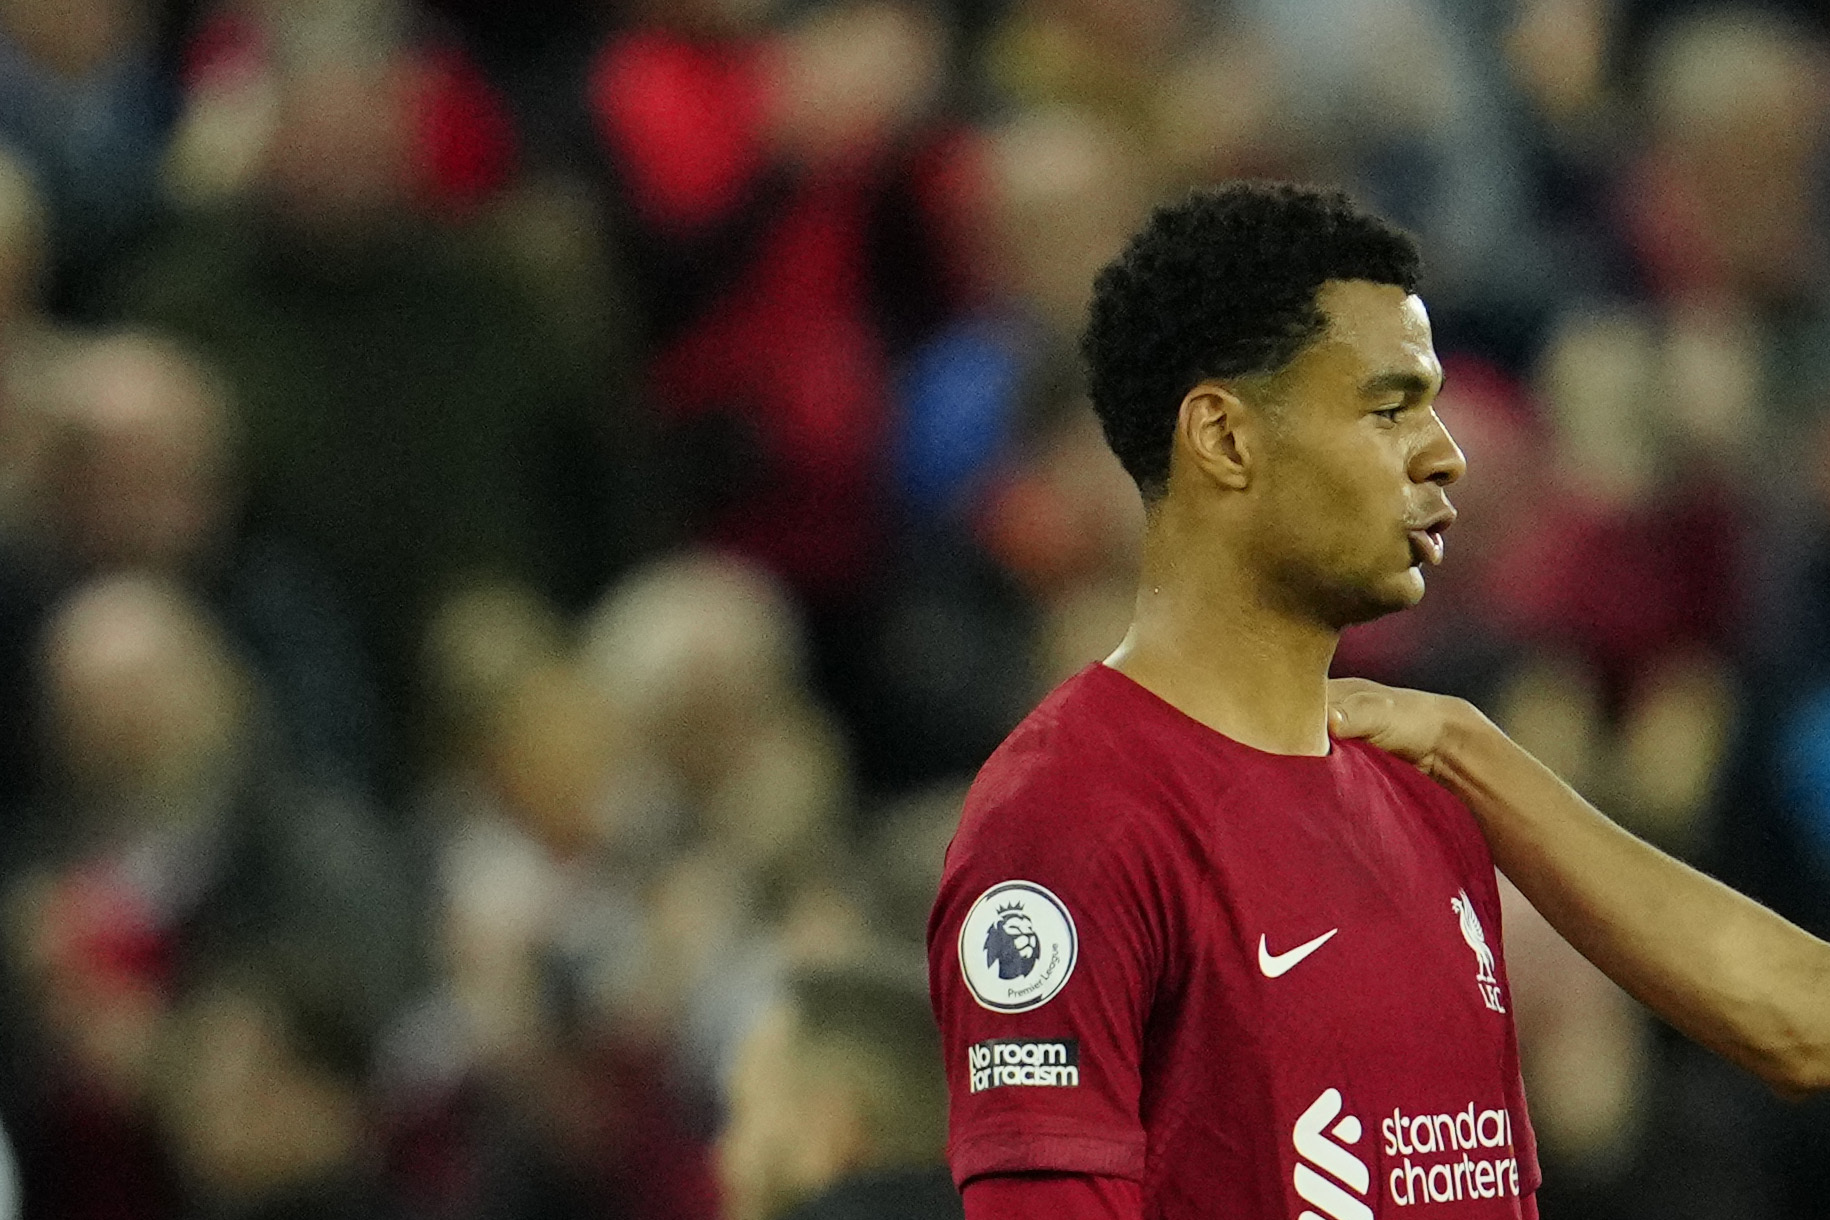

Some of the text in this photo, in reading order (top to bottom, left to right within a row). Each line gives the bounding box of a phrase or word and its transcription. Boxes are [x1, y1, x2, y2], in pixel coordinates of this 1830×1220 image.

[1007, 942, 1060, 998] Premier League
[969, 1042, 1067, 1069] No room
[993, 1062, 1080, 1086] racism
[1389, 1152, 1520, 1206] chartere
